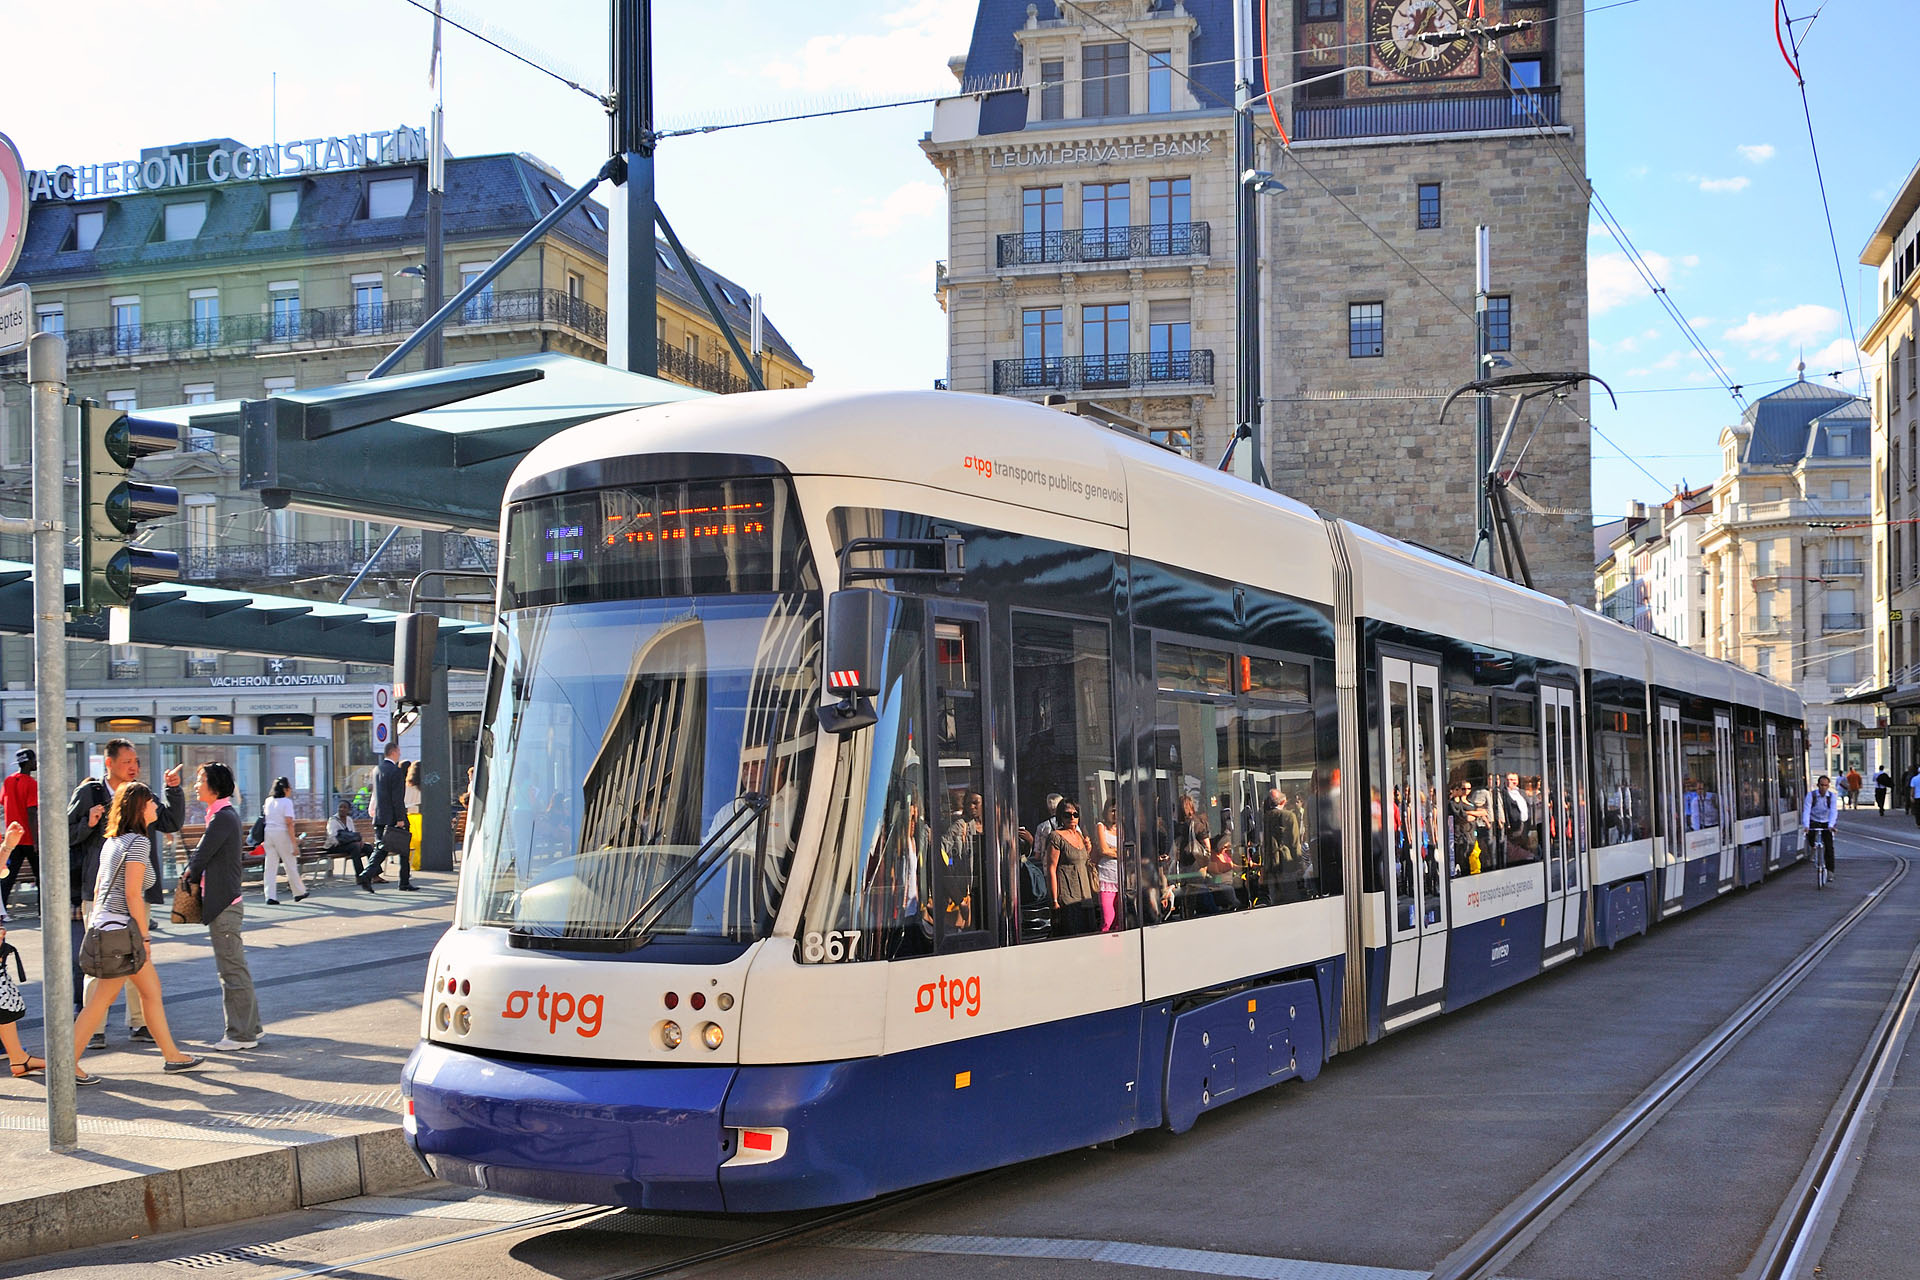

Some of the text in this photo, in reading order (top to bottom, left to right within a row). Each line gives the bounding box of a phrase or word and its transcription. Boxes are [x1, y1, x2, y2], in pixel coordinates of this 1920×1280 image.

[207, 126, 426, 182] CONSTANTIN
[991, 138, 1212, 169] LEUMI PRIVATE BANK
[994, 459, 1047, 485] transports
[1048, 474, 1083, 491] publics
[1084, 482, 1124, 504] genevois
[1889, 611, 1902, 620] 25
[210, 674, 345, 687] VACHERON CONSTANTIN
[803, 931, 862, 963] 867
[537, 984, 605, 1038] tpg
[937, 973, 982, 1018] tpg
